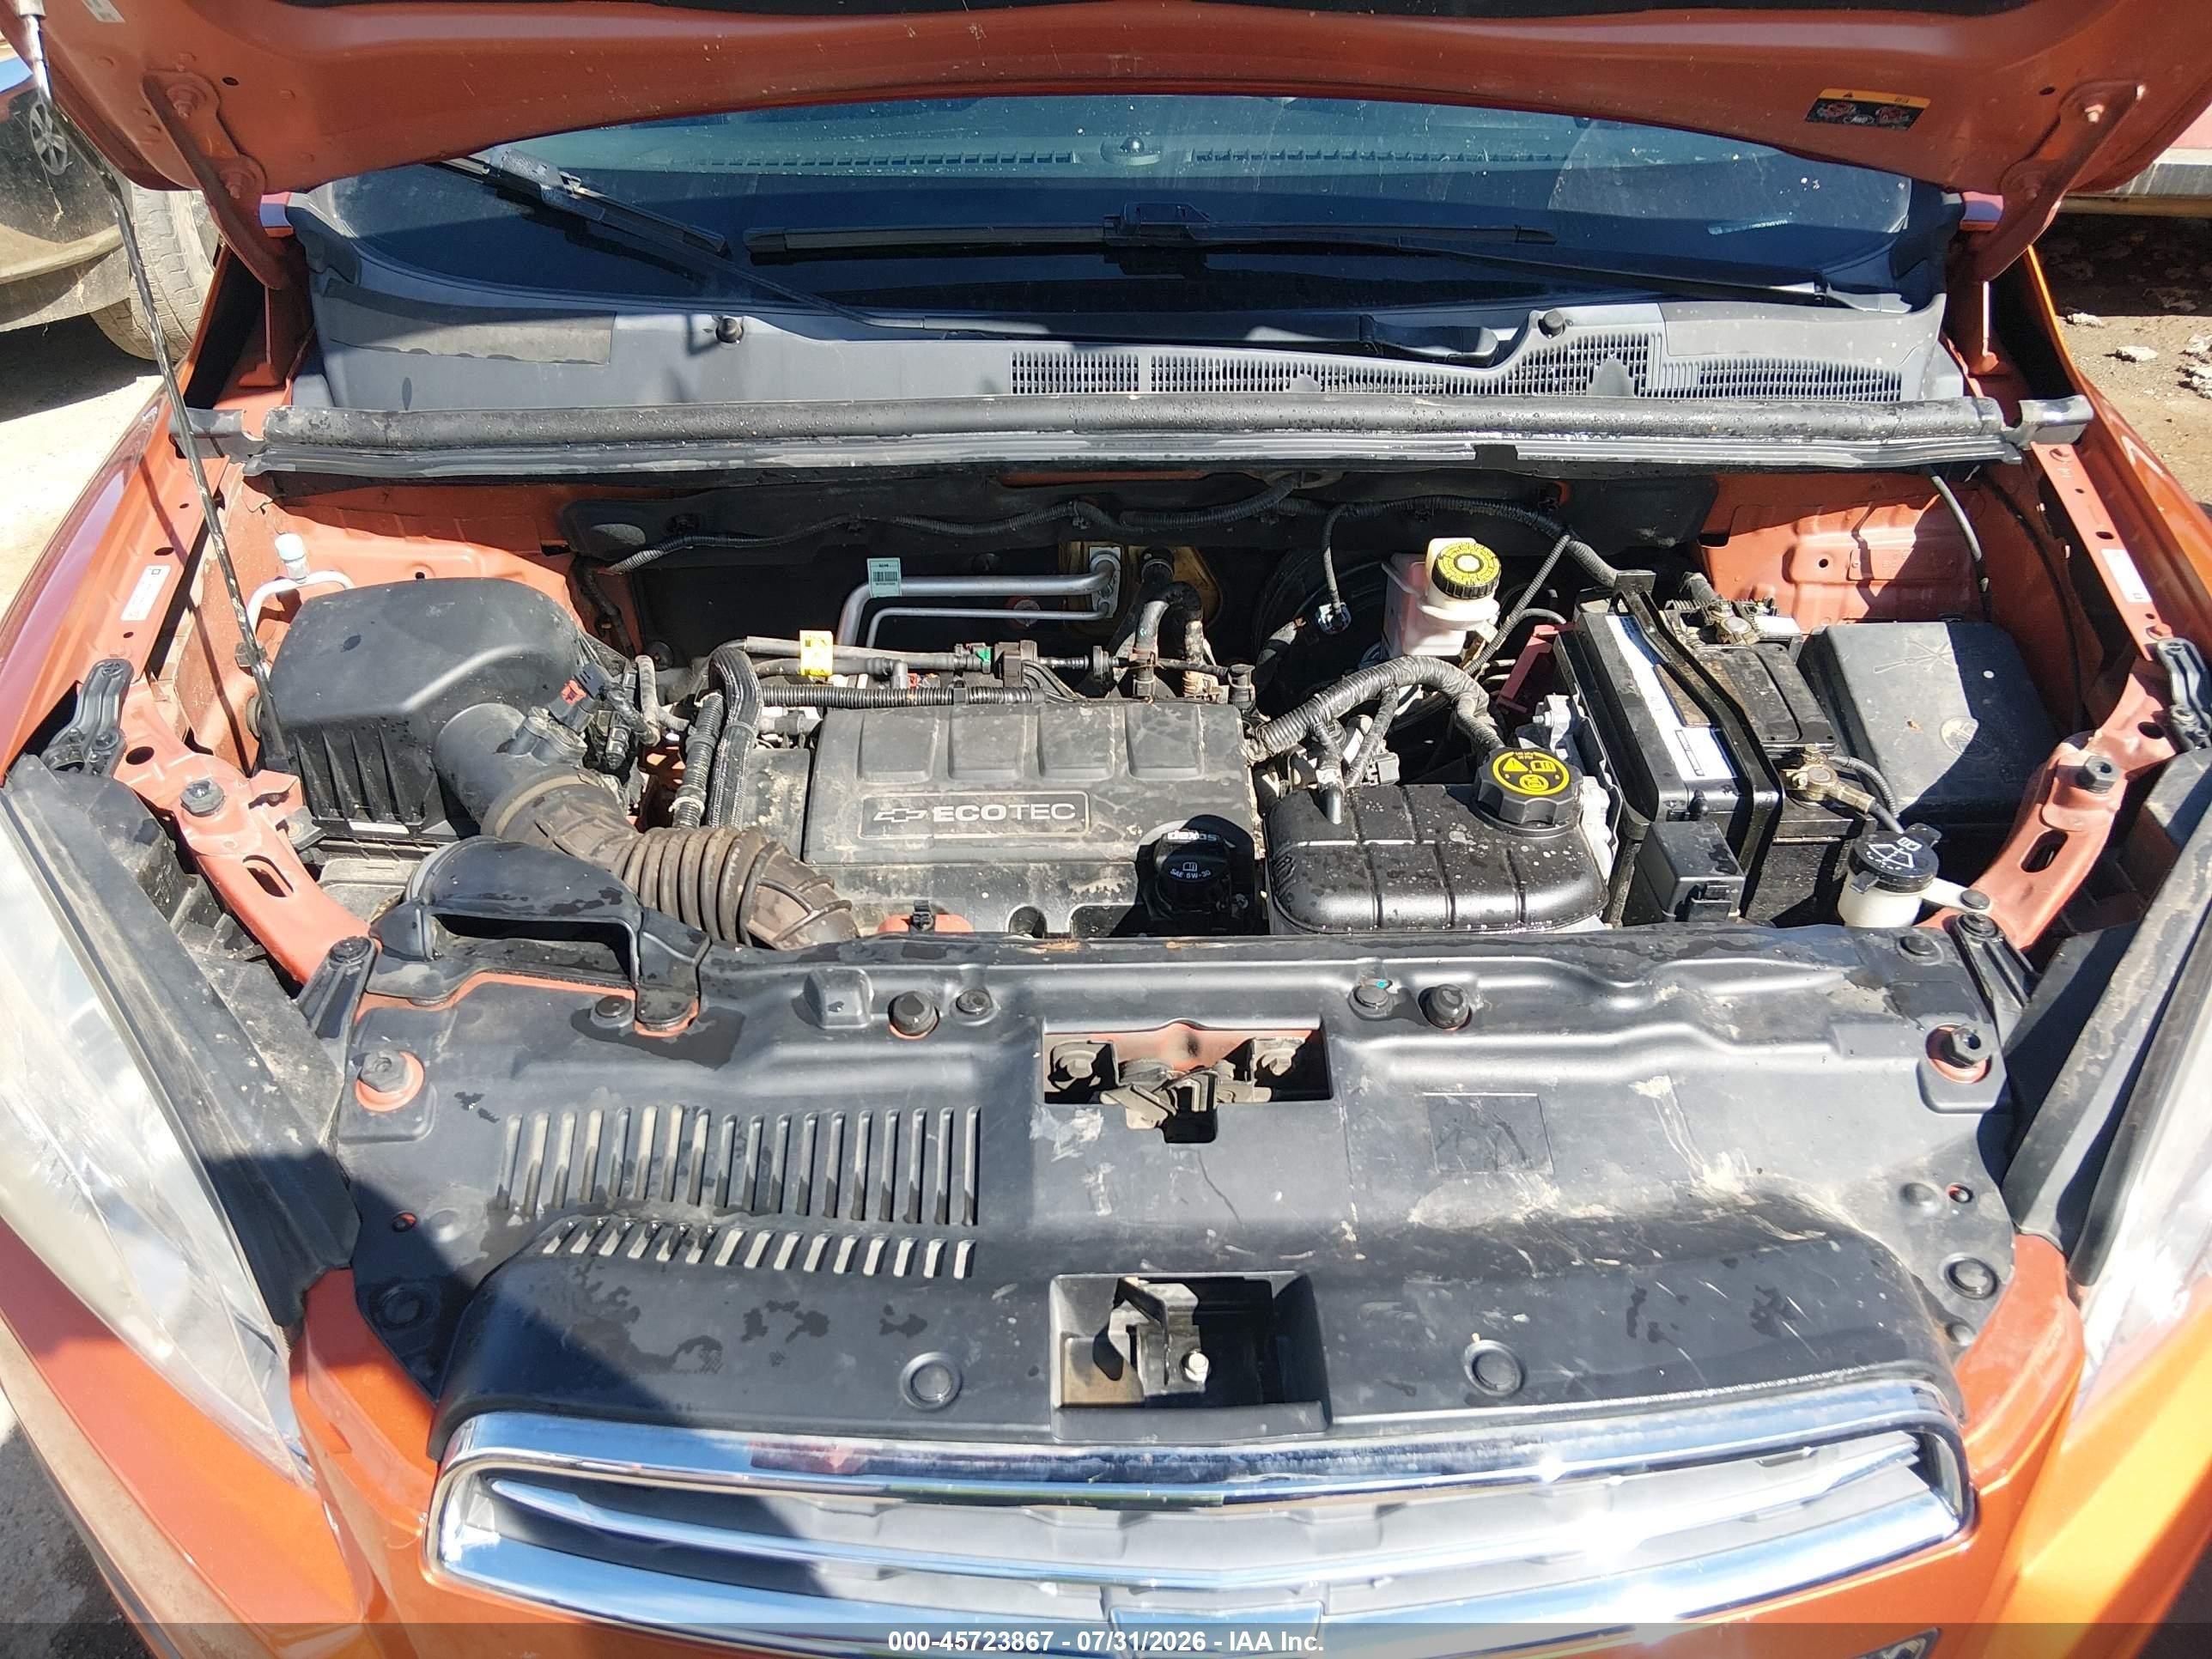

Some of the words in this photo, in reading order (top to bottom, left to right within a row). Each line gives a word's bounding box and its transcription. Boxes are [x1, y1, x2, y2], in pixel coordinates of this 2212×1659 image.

[933, 803, 1076, 823] ECOTEC
[1168, 830, 1217, 841] dexos
[1170, 869, 1183, 878] SAE
[1186, 870, 1212, 879] 5W-30
